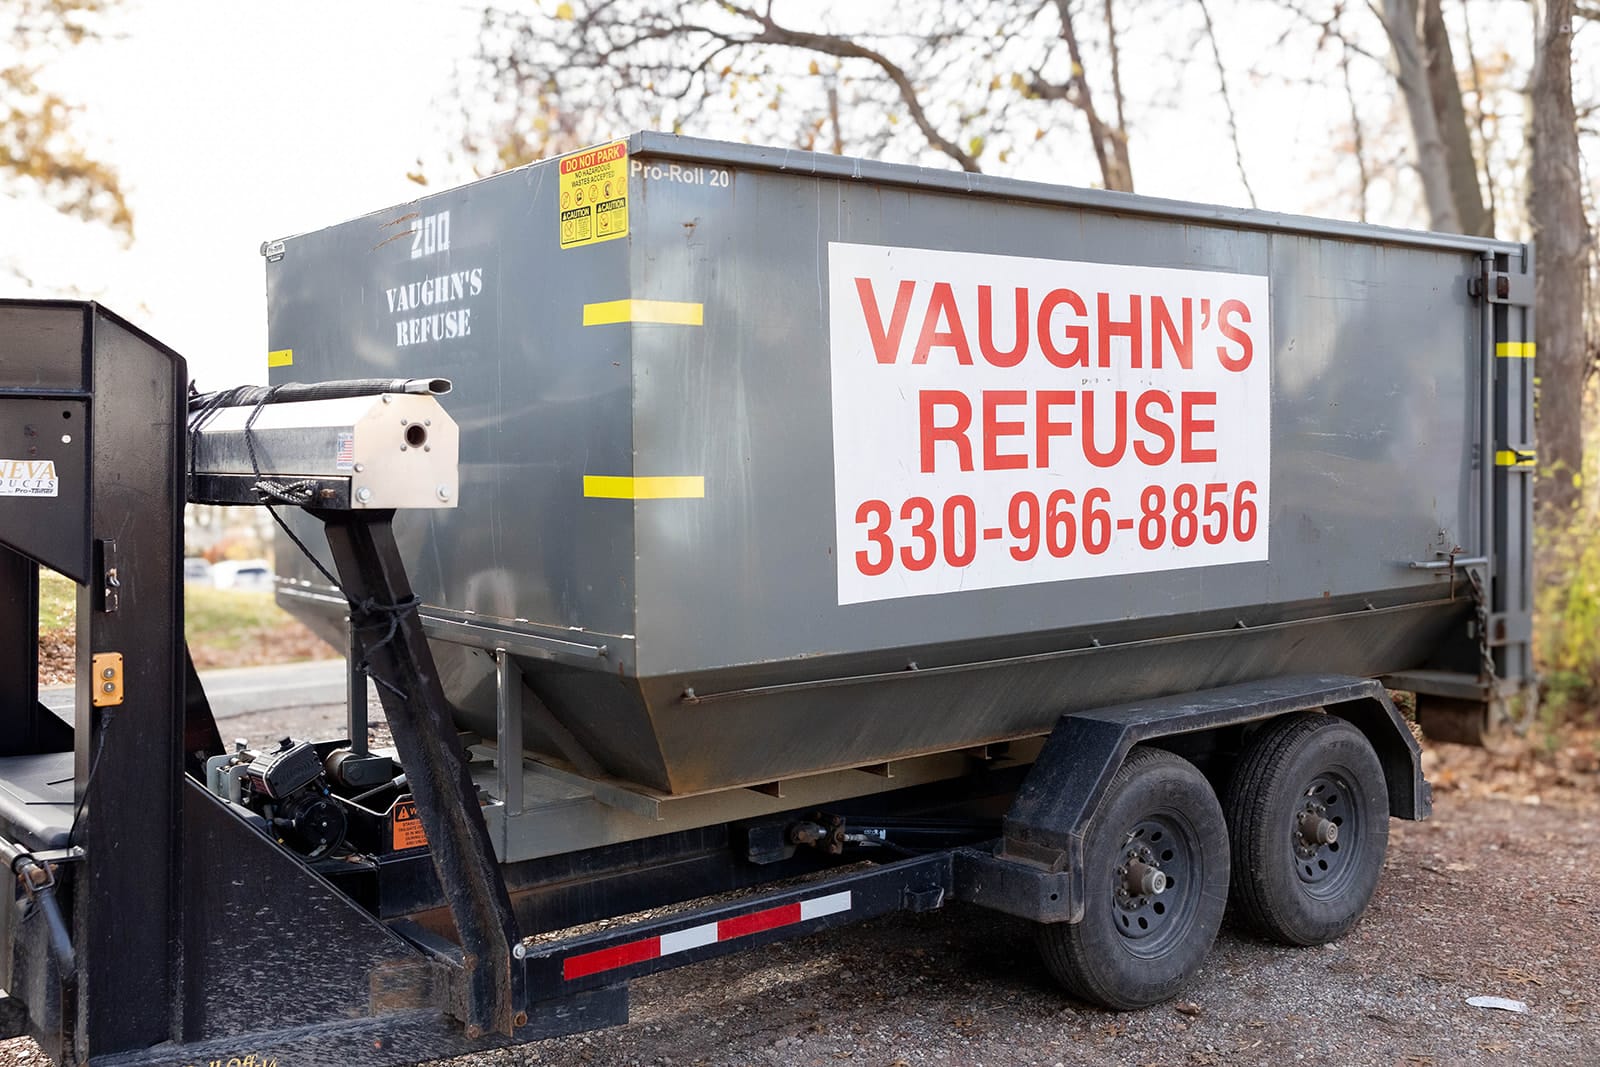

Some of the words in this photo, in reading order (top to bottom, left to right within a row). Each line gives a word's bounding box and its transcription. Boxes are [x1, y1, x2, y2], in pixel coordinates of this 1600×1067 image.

[566, 158, 578, 172] DO
[579, 153, 596, 168] NOT
[597, 146, 620, 164] PARK
[583, 163, 611, 176] HAZARDOUS
[571, 176, 590, 187] WASTES
[591, 170, 615, 184] ACCEPTED
[630, 160, 704, 185] Pro-Roll
[709, 169, 729, 188] 20
[566, 207, 590, 219] CAUTION
[601, 198, 625, 211] CAUTION
[385, 268, 483, 313] VAUGHN'S
[396, 308, 471, 347] REFUSE
[854, 277, 1254, 373] VAUGHN'S
[918, 389, 1217, 474] REFUSE
[855, 480, 1258, 577] 330-966-8856
